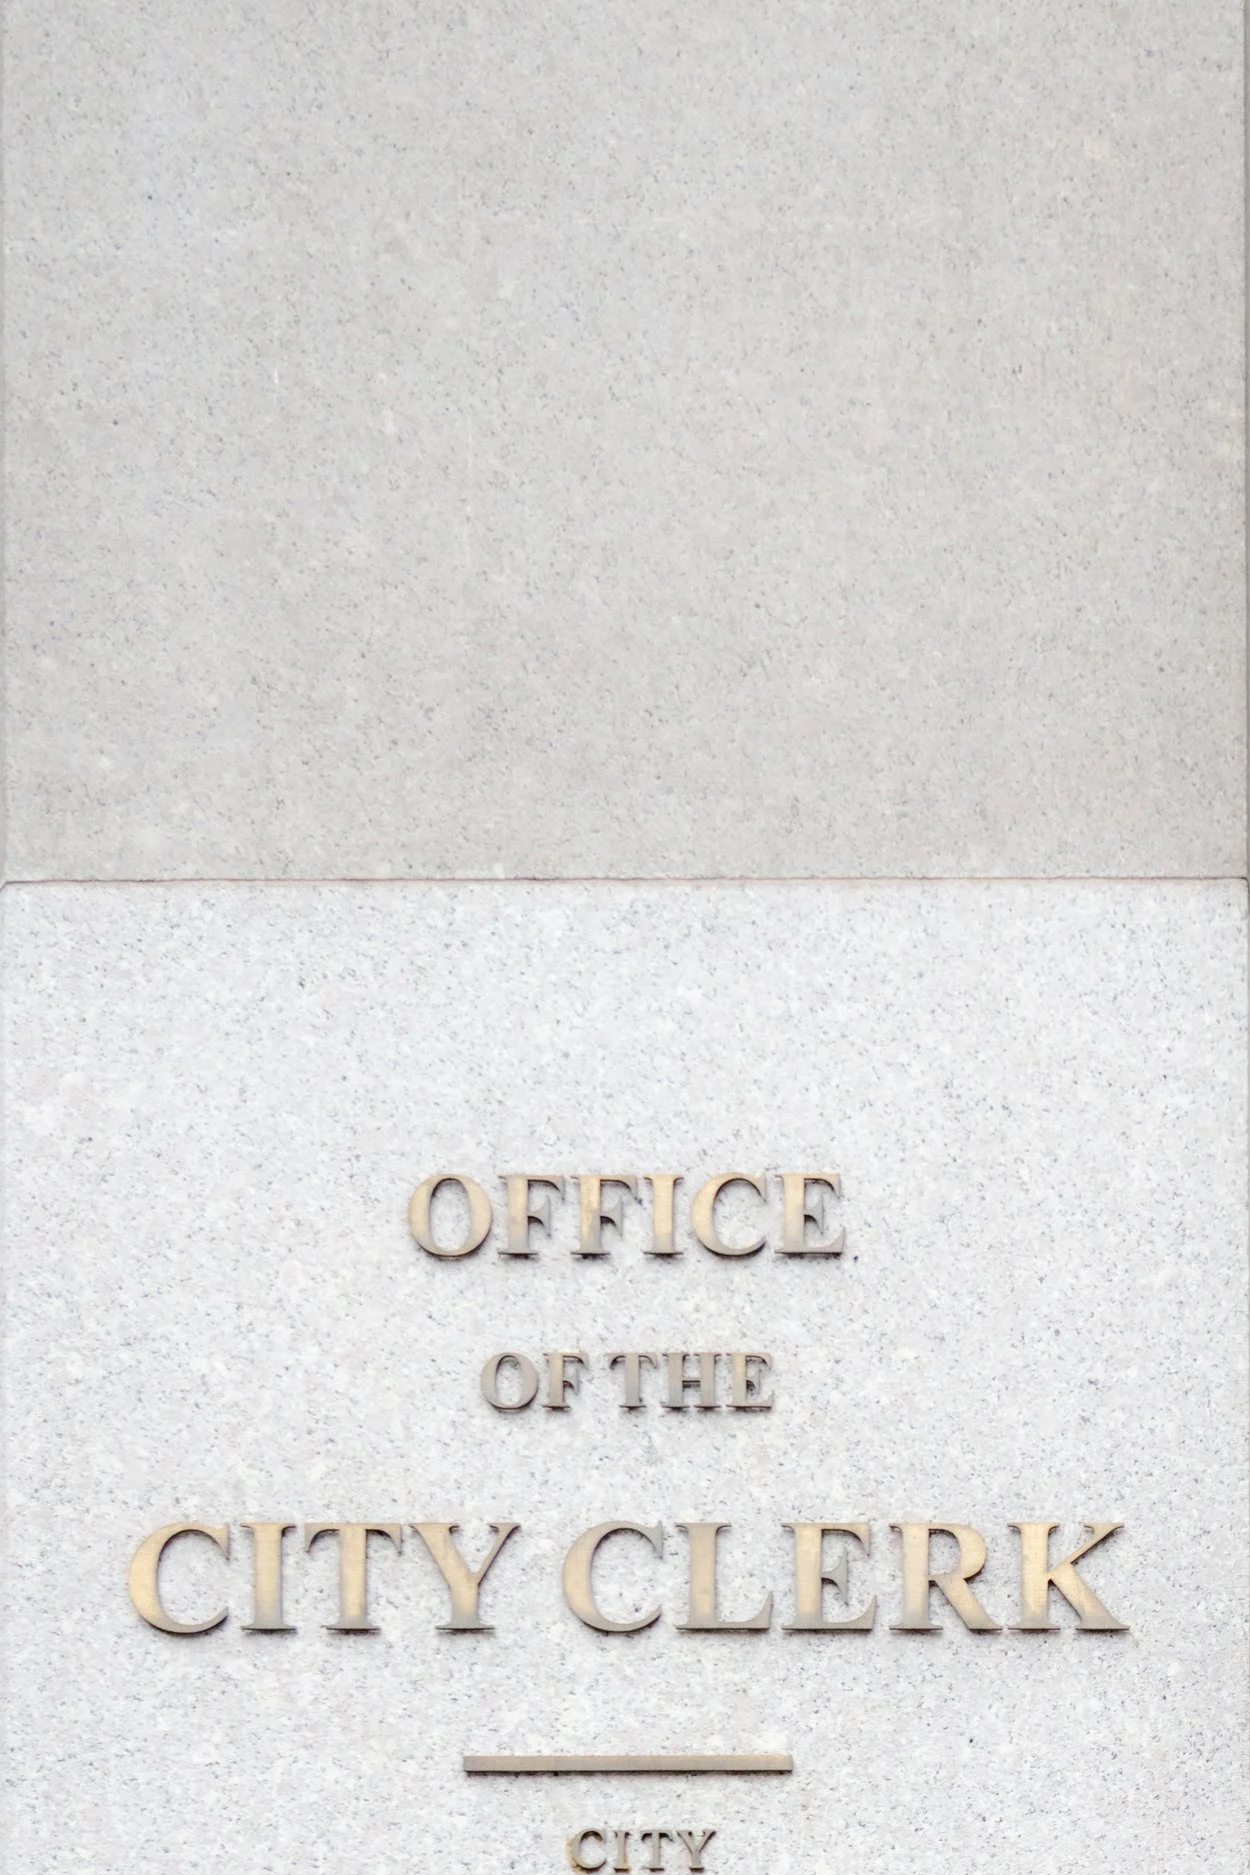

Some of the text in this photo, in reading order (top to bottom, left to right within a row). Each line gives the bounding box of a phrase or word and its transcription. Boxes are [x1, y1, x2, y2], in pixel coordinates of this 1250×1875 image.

[406, 1171, 846, 1260] OFFICE
[480, 1350, 776, 1413] OF THE
[128, 1520, 1130, 1635] CITY CLERK
[566, 1827, 718, 1875] CITY
